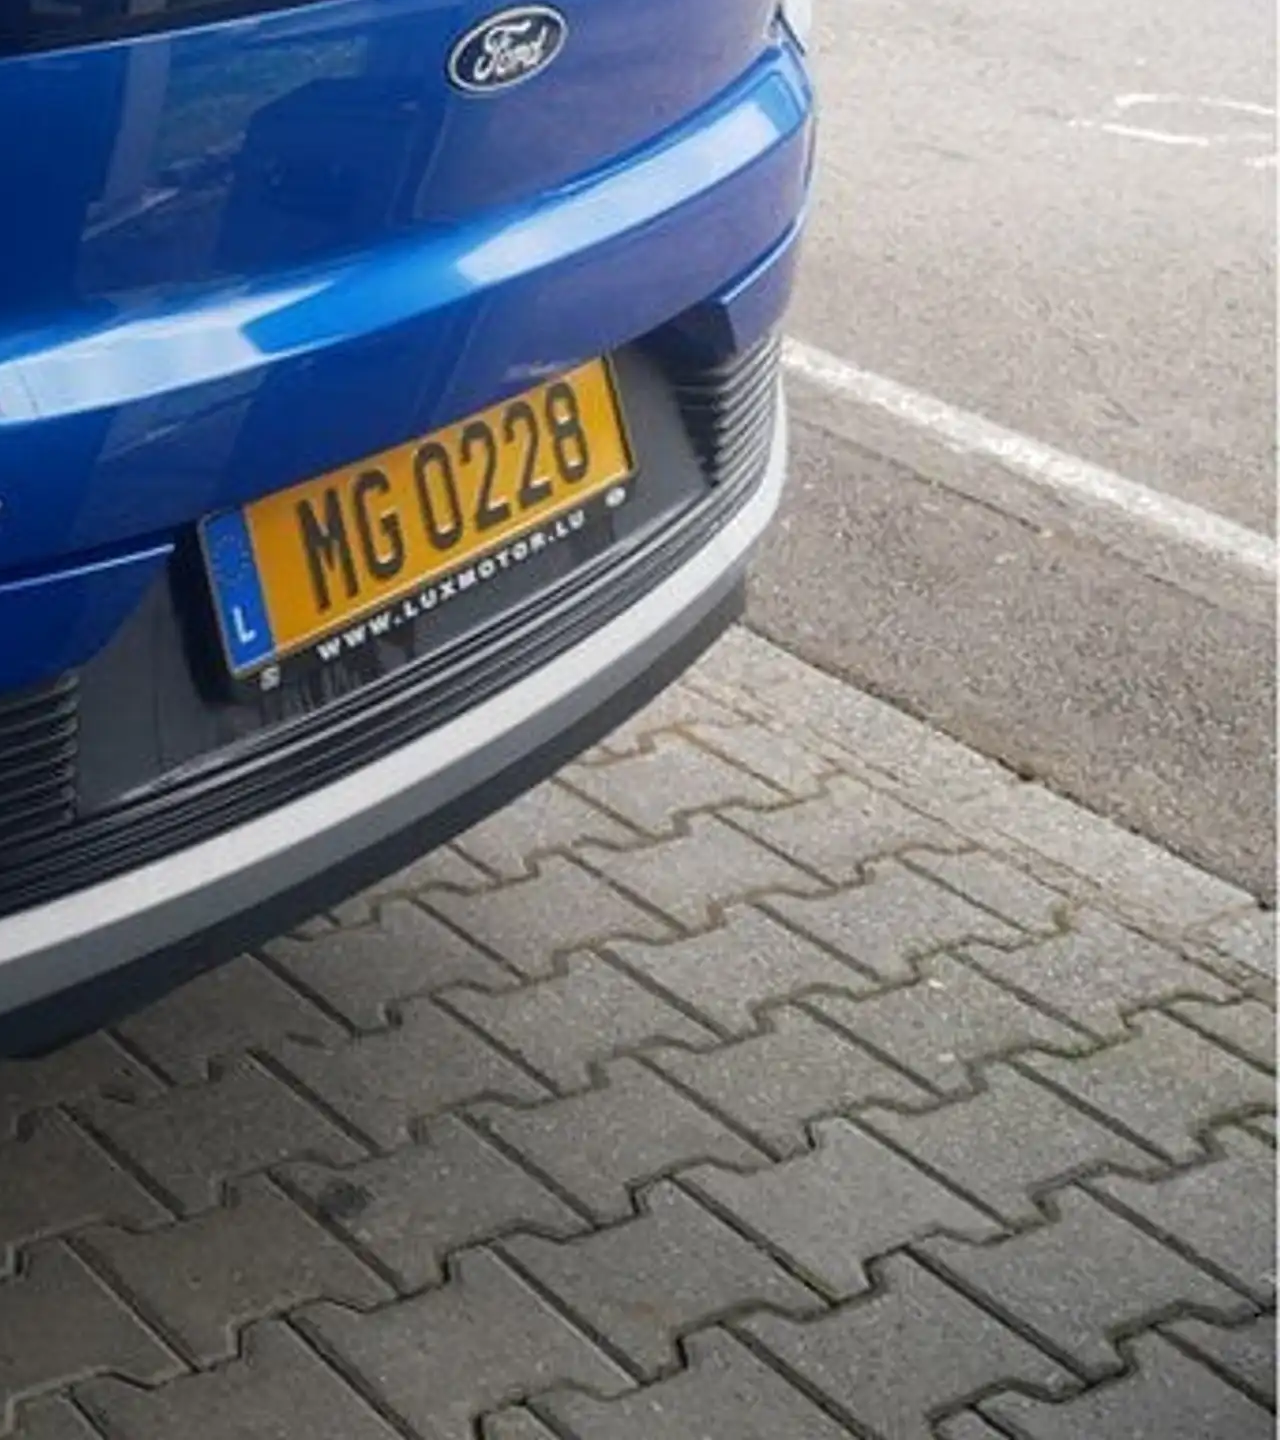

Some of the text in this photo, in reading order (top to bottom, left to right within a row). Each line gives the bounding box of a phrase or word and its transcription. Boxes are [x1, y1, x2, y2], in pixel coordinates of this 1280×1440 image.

[297, 381, 590, 612] MG 0228
[232, 607, 256, 644] L
[316, 509, 587, 662] WWW.LUXMOTOR.LU
